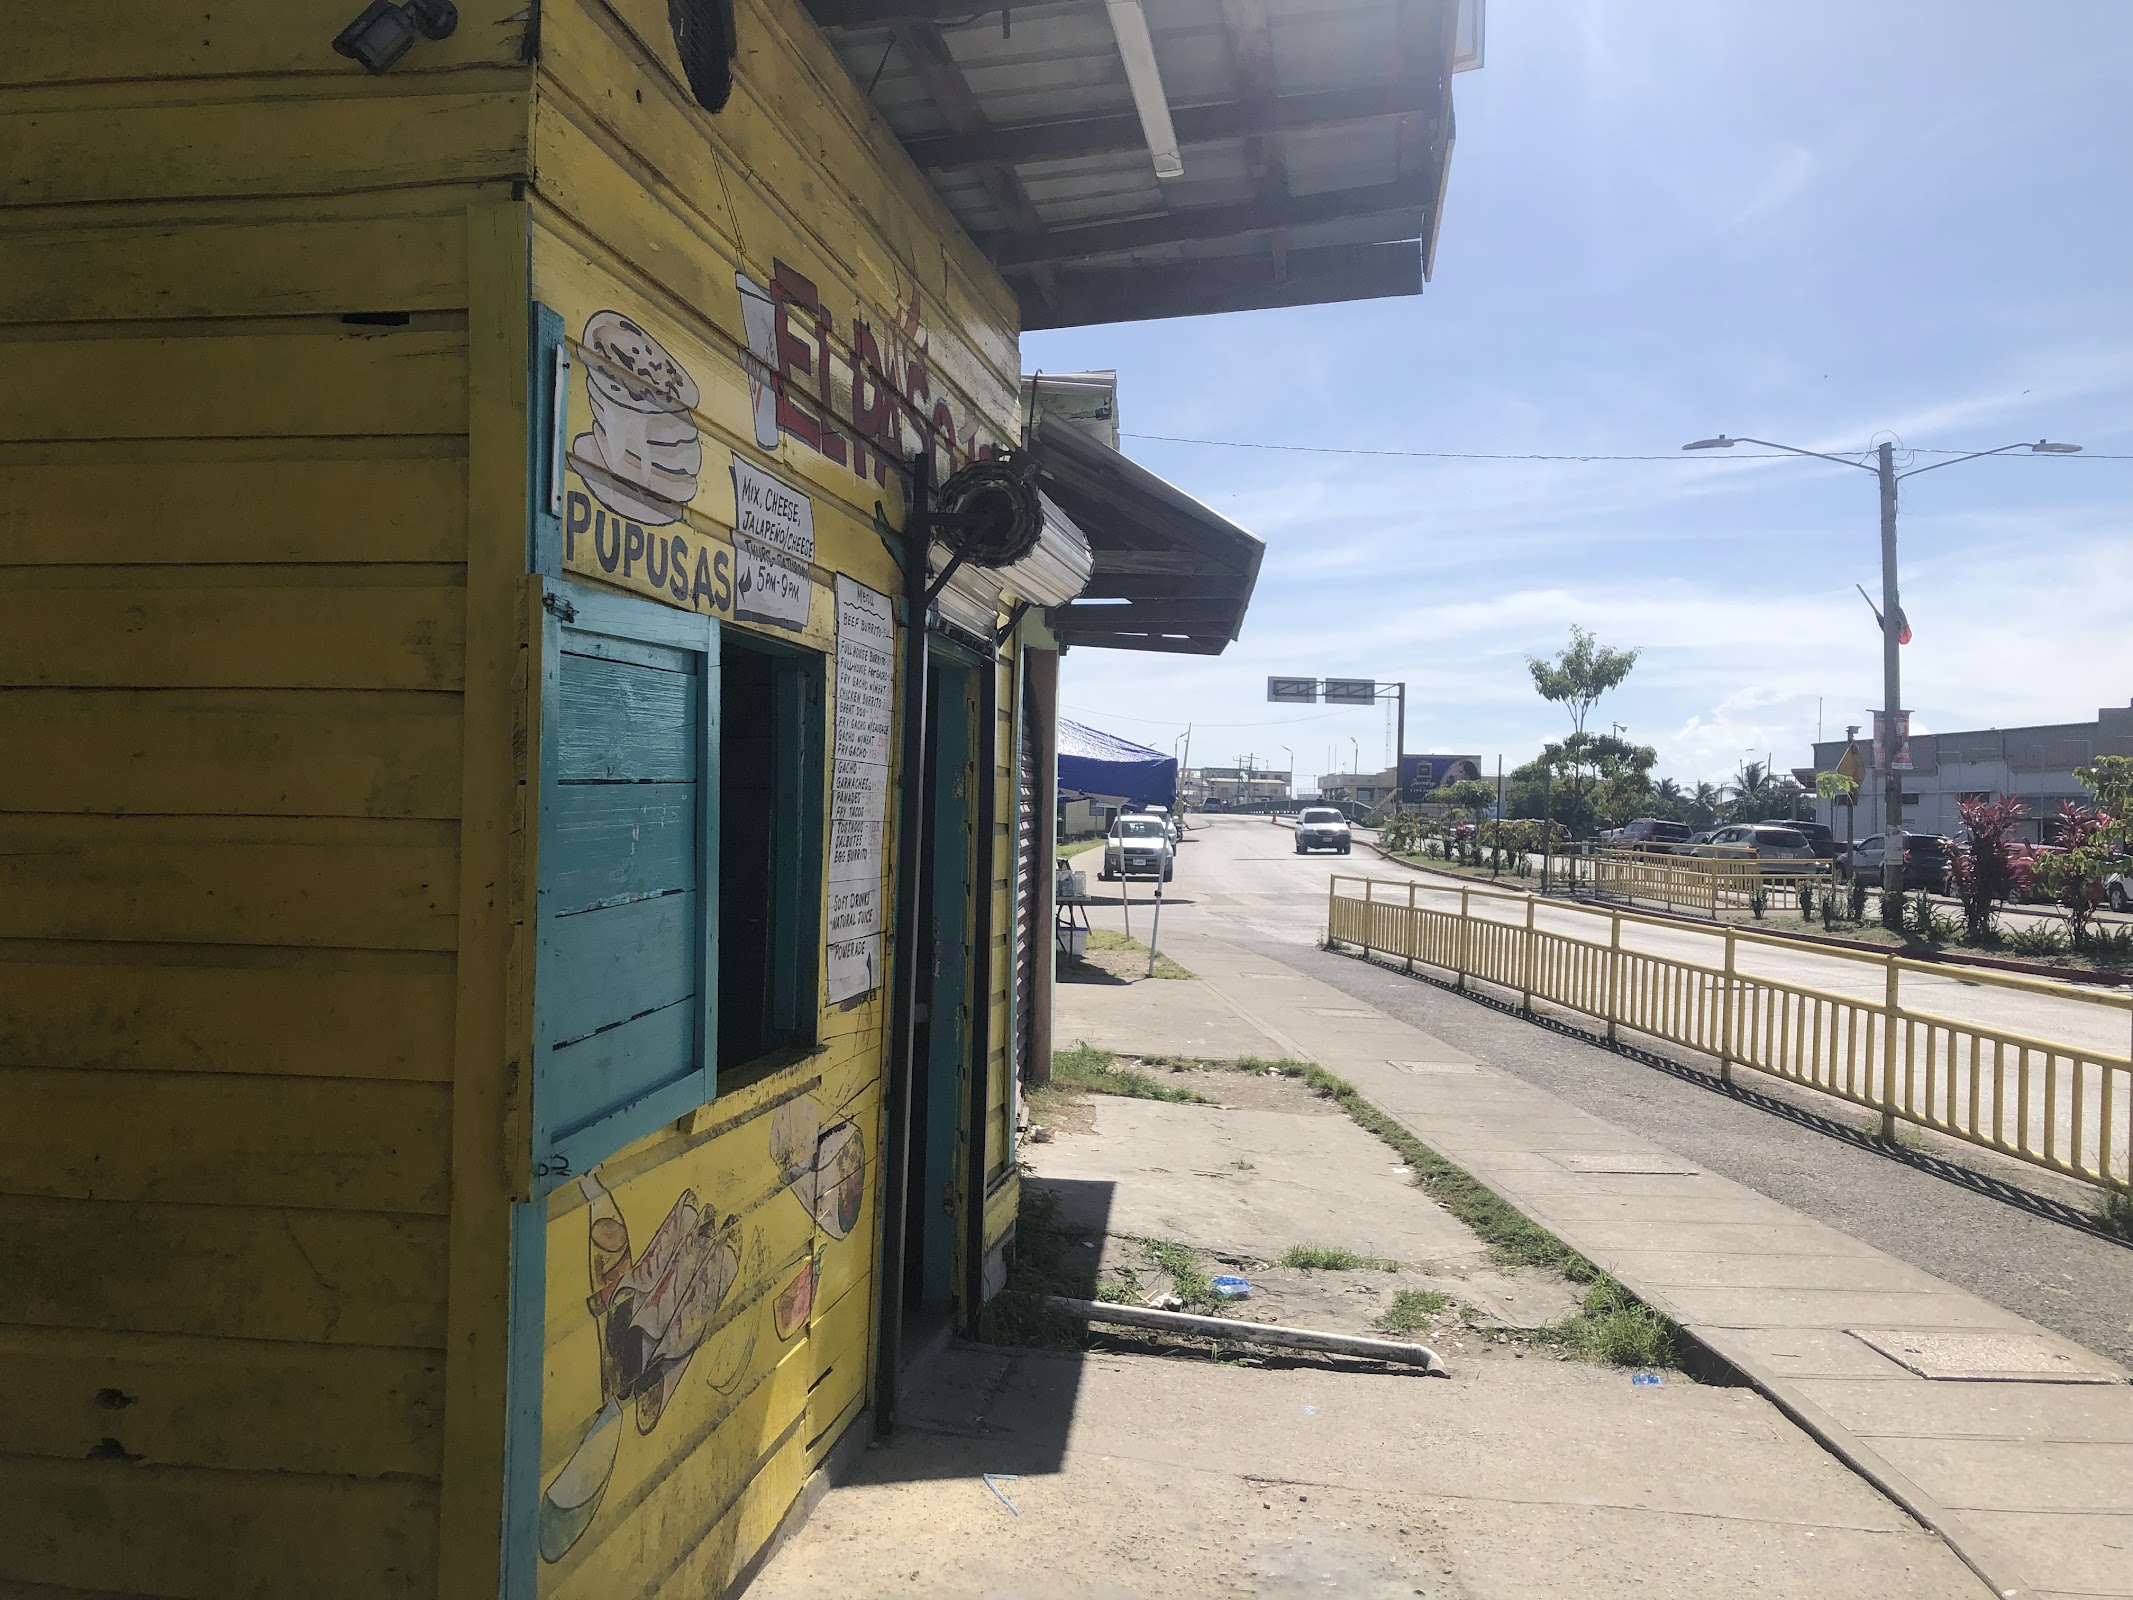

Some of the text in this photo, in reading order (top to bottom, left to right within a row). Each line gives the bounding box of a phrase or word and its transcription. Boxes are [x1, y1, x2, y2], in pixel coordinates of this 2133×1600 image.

[765, 488, 801, 527] CHEESE,
[743, 510, 814, 558] JALAPEÑO/CHEESE
[566, 490, 731, 612] PUPUSAS
[843, 612, 859, 628] BEEF
[839, 672, 850, 685] FRY
[848, 805, 865, 818] TACOS
[833, 894, 848, 912] SOFT
[857, 908, 873, 925] JUICE
[834, 940, 866, 960] POWERADE
